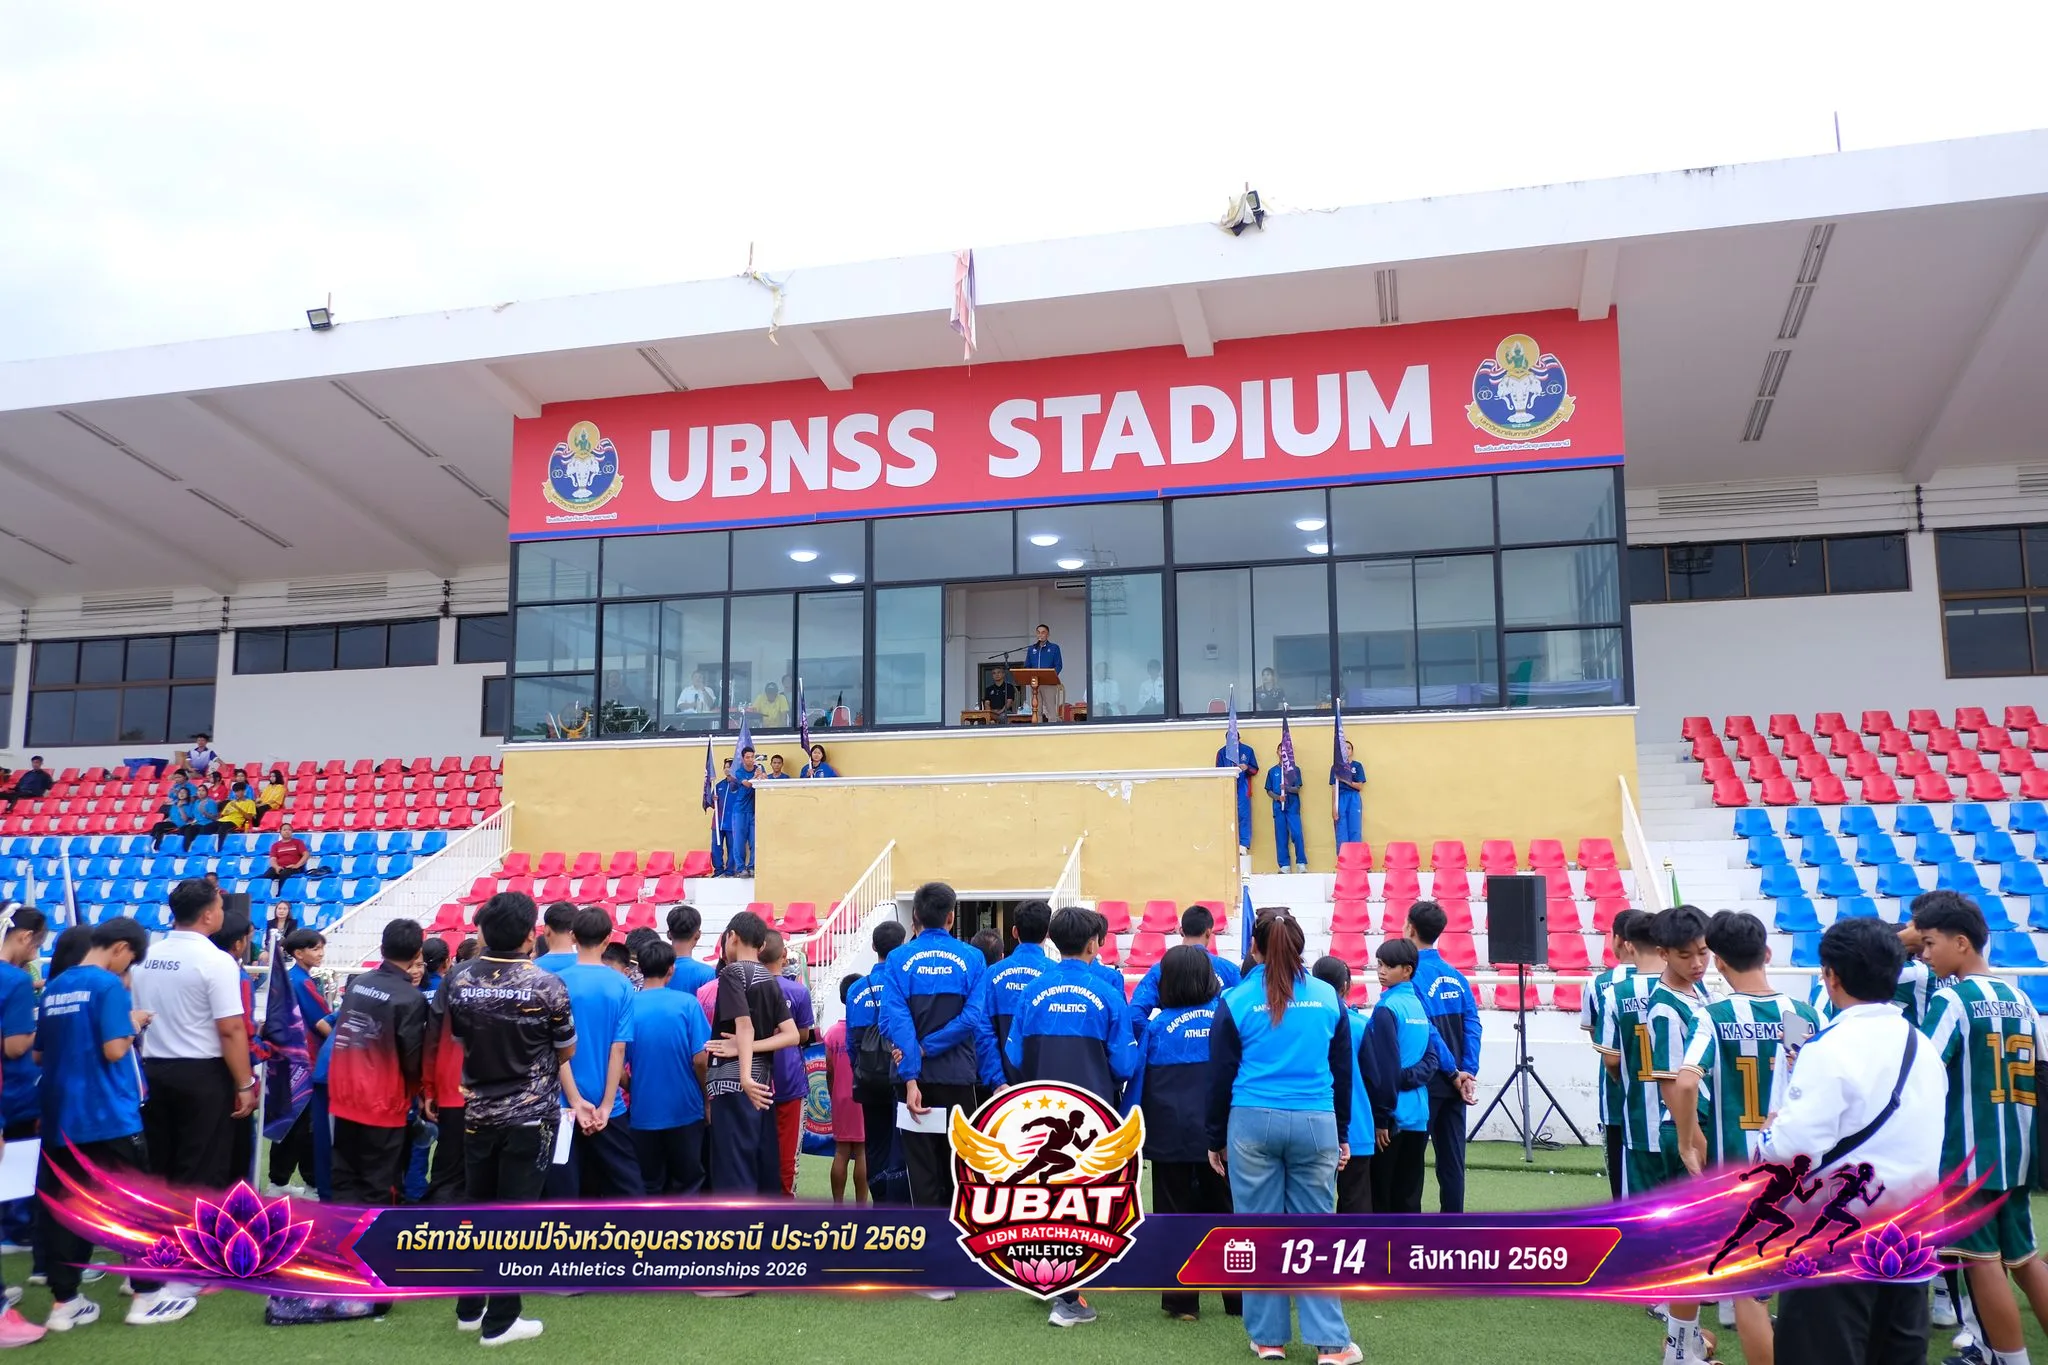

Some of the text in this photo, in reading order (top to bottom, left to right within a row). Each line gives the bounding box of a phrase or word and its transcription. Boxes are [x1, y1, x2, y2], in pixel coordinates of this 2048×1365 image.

[650, 364, 1433, 502] UBNSS STADIUM
[144, 959, 181, 971] UBNSS
[917, 966, 953, 975] ATHLETICS
[460, 987, 533, 1002] อุบลราชธานี
[1048, 1003, 1087, 1013] ATHLETICS
[1985, 1032, 2037, 1107] 12
